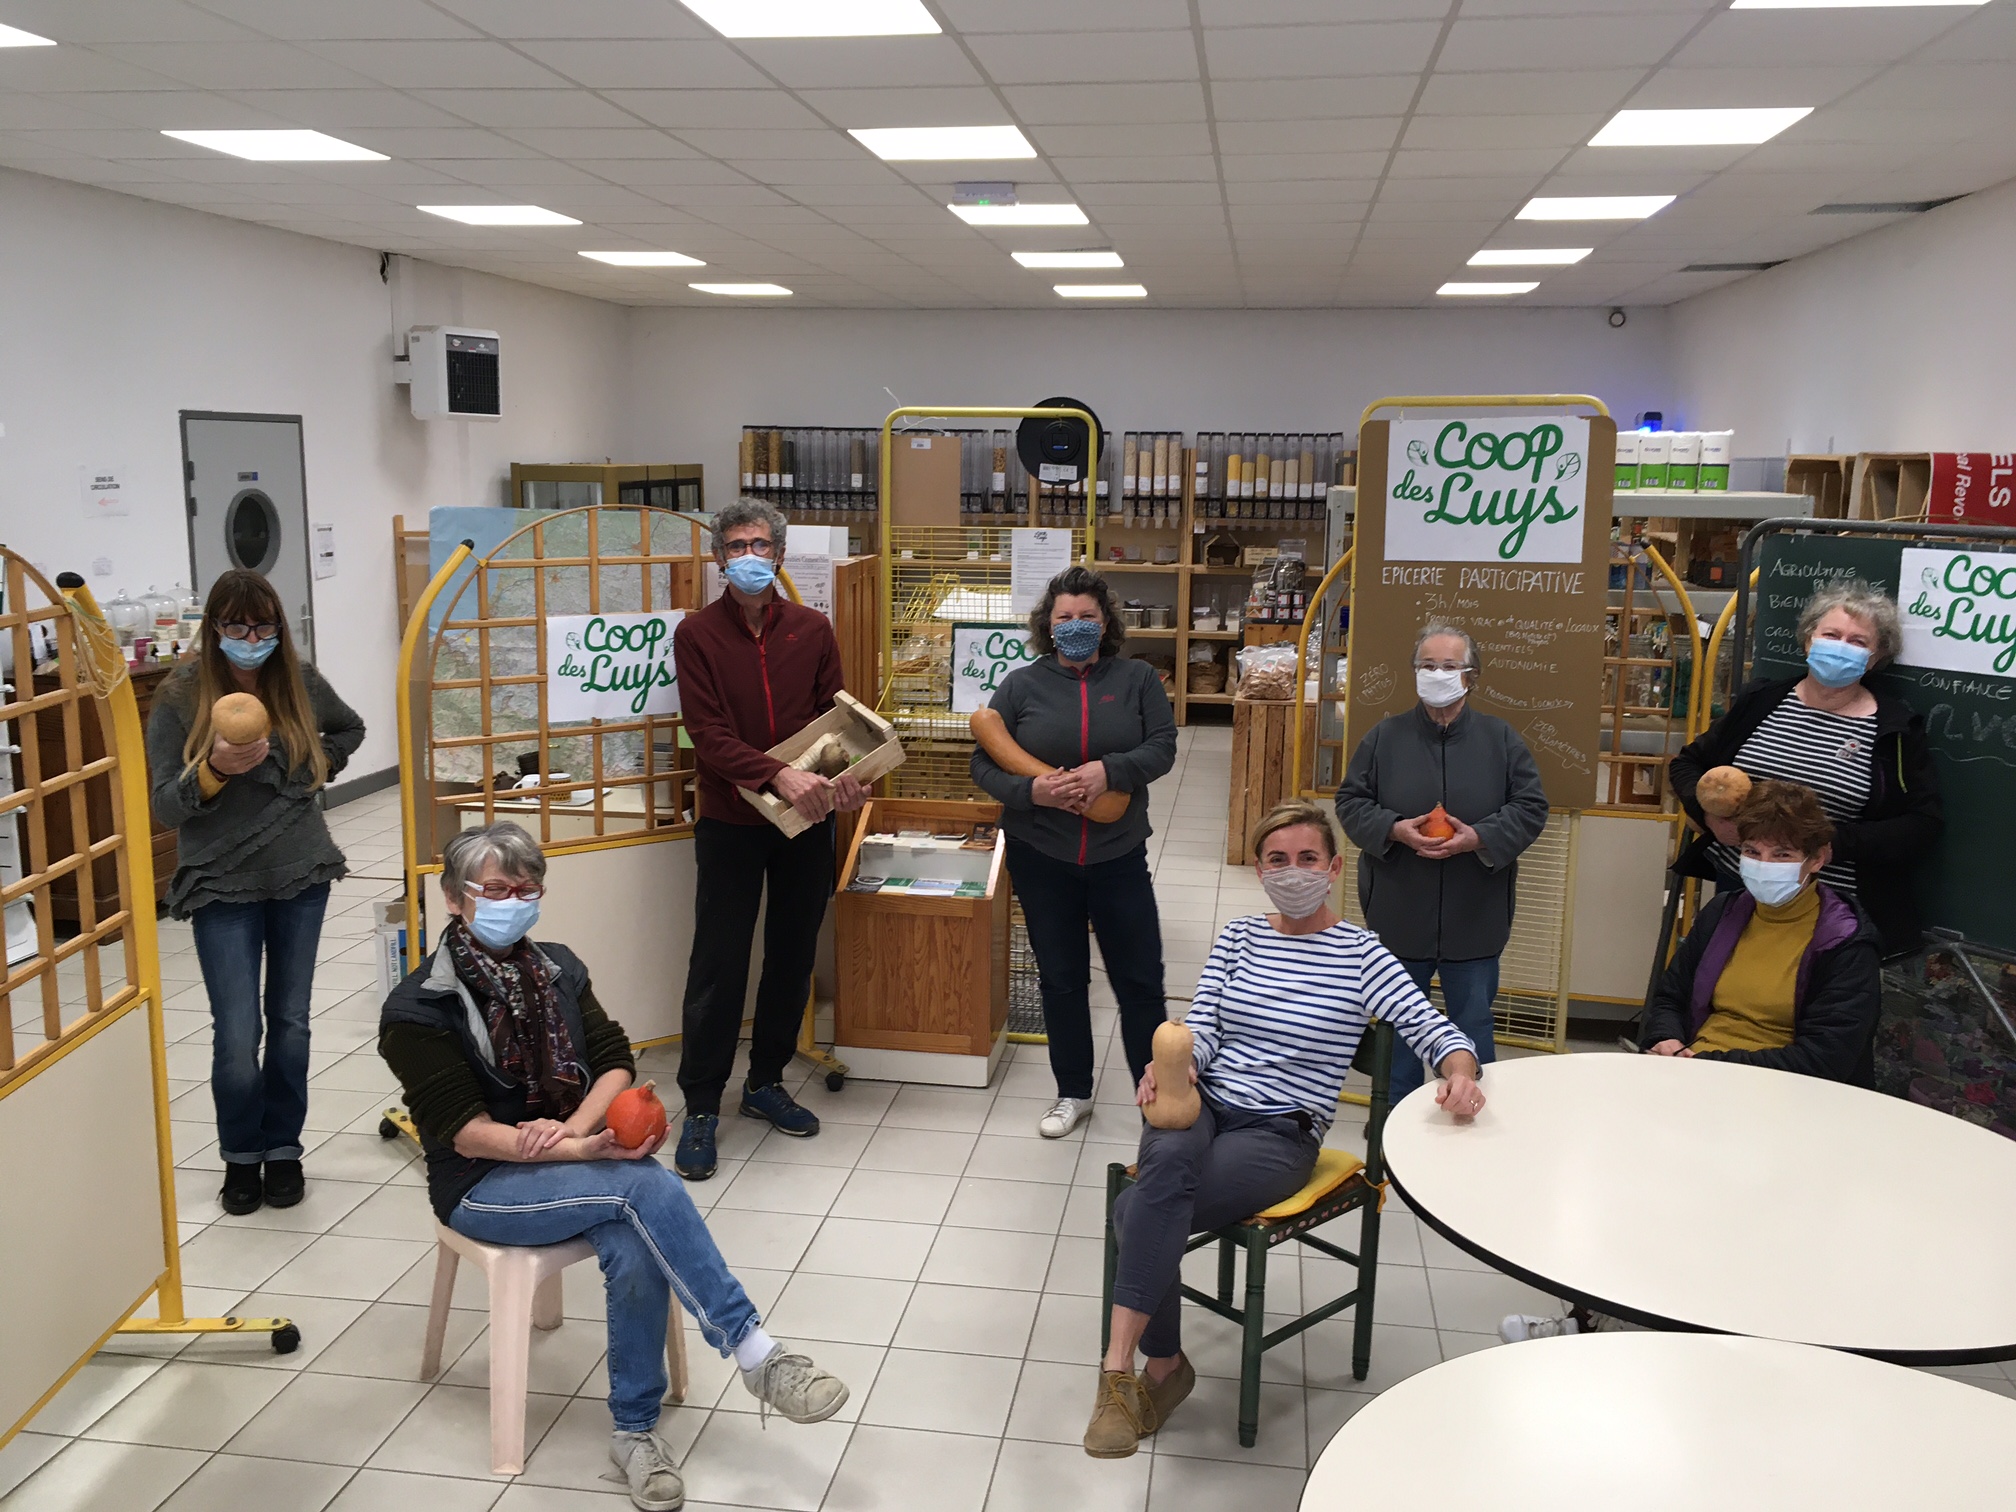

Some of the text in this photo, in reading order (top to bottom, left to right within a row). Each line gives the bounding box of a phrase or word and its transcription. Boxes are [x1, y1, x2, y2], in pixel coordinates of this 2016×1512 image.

[1392, 469, 1579, 559] des Luys
[1943, 554, 2016, 600] Coo
[1908, 591, 2016, 673] des Luy
[557, 653, 677, 714] des Luys
[961, 658, 987, 679] des
